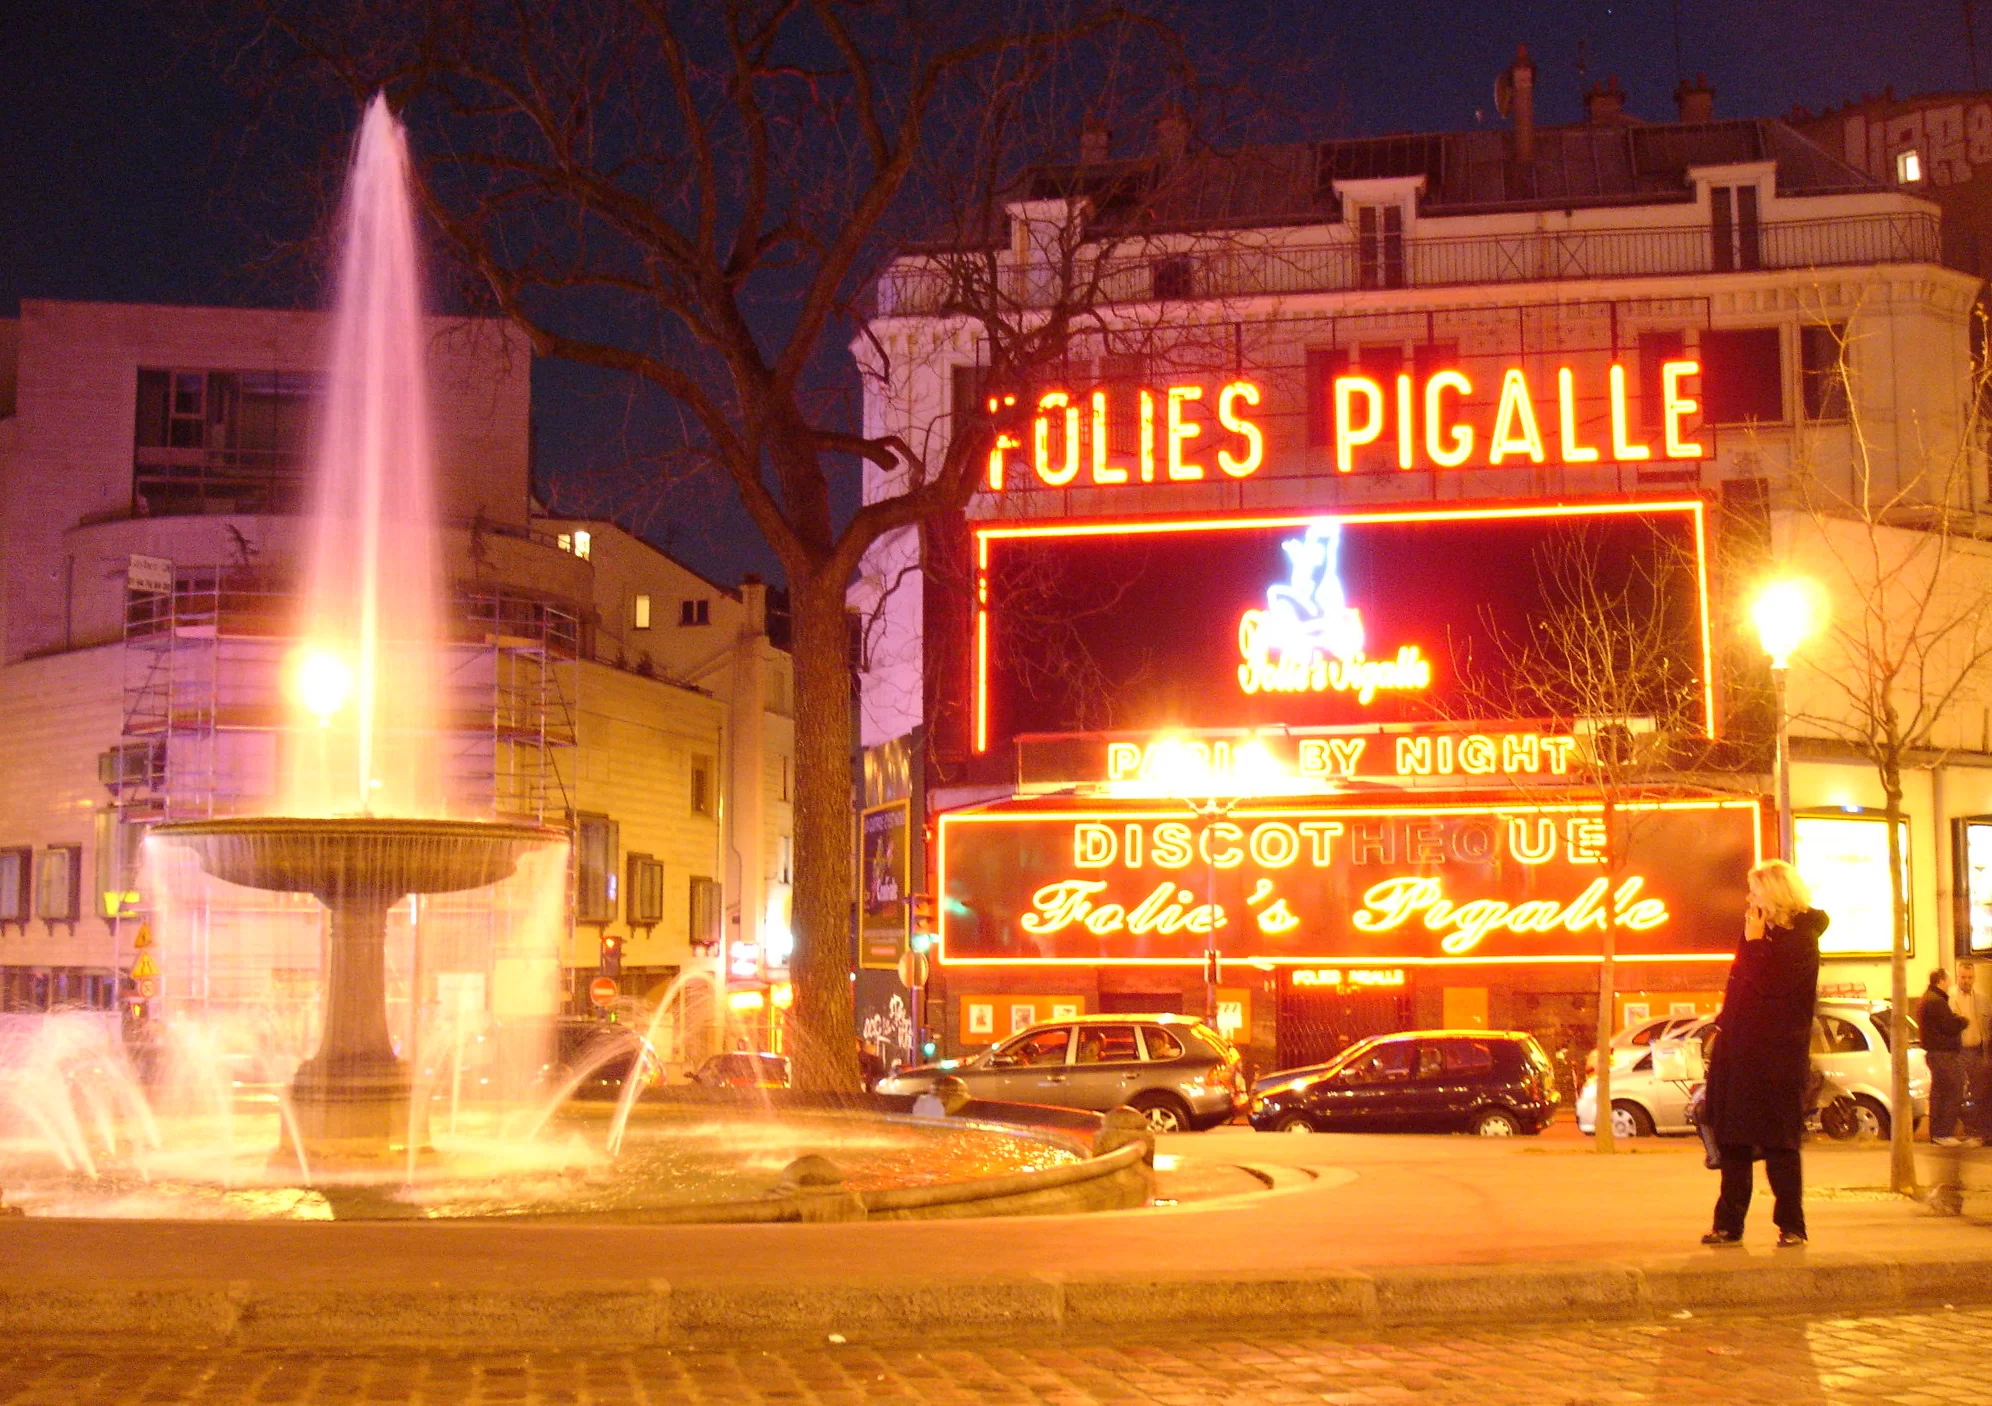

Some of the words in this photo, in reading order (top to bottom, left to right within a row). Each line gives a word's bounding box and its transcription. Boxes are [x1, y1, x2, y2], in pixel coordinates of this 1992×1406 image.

[1334, 361, 1703, 473] PIGALLE
[1299, 737, 1366, 777] BY
[1395, 734, 1576, 776] NIGHT
[1073, 818, 1609, 869] DISCOTHEQUE
[1020, 877, 1301, 936] Folie's
[1351, 874, 1670, 954] Pigalle
